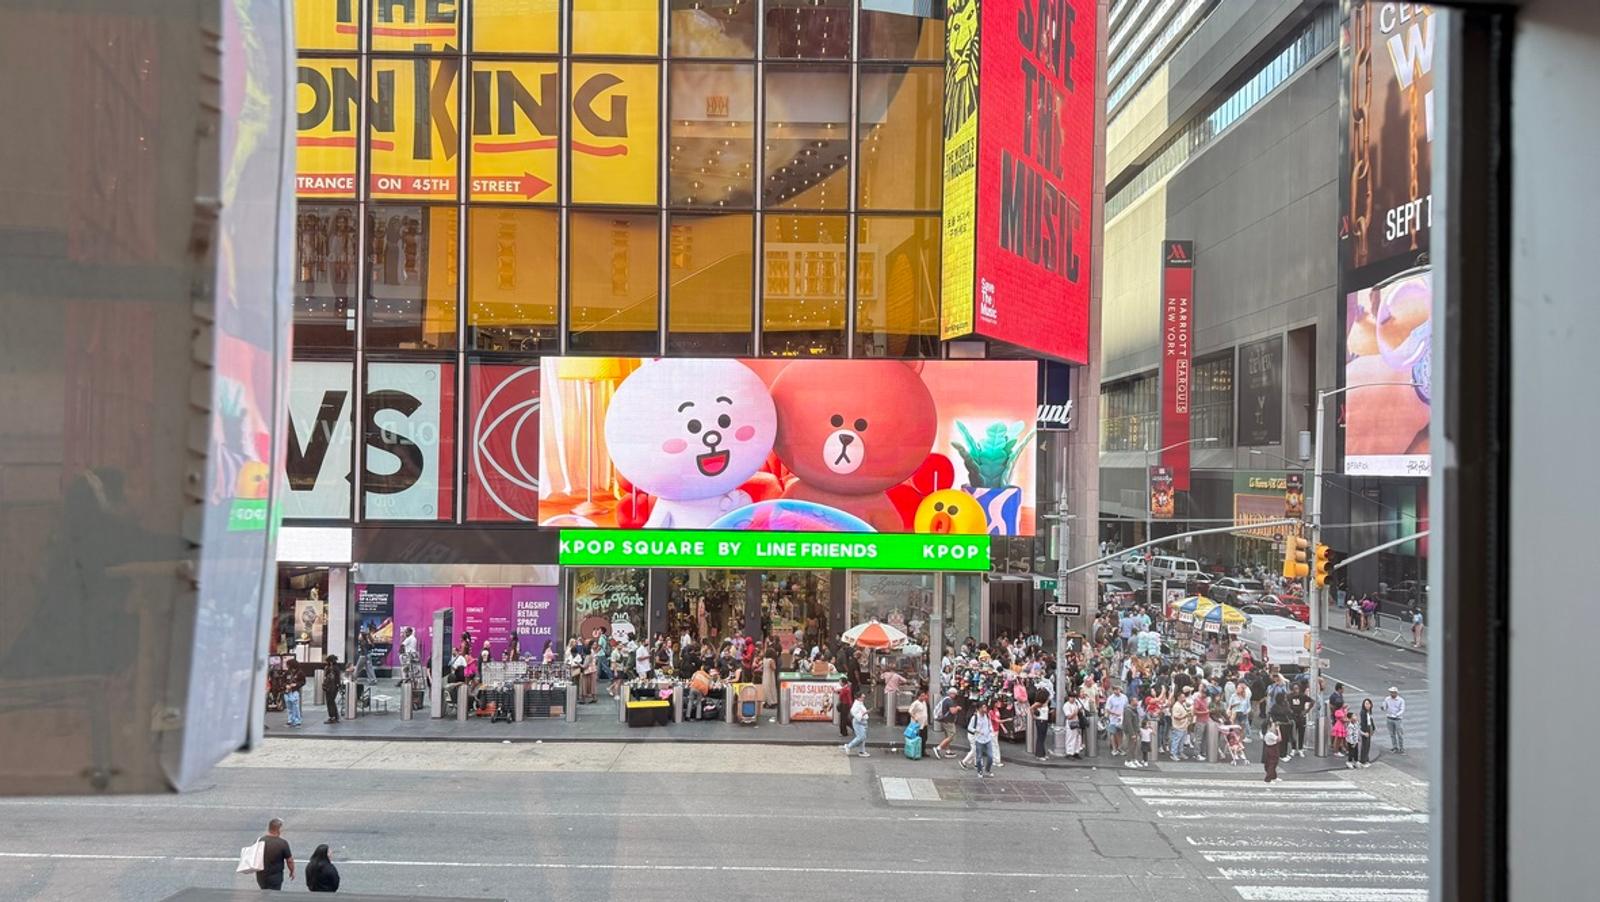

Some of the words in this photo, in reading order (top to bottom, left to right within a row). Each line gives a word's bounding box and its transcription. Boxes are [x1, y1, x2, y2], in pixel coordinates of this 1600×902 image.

[412, 44, 628, 160] KING
[1021, 56, 1066, 180] THE
[378, 178, 402, 190] ON
[412, 178, 449, 191] 45TH
[473, 180, 521, 193] STREET
[1000, 148, 1080, 284] MUSIC
[1386, 198, 1423, 241] SEPT
[1167, 298, 1176, 322] NEW
[1179, 298, 1188, 357] MARRIOTT
[1167, 328, 1176, 356] YORK
[560, 540, 615, 554] KPOP
[622, 540, 705, 556] SQUARE
[718, 542, 742, 556] BY
[756, 543, 797, 557] LINE
[801, 544, 878, 558] FRIENDS
[923, 545, 979, 559] KPOP
[517, 601, 550, 609] FLAGSHIP
[576, 596, 611, 611] New
[611, 593, 644, 608] York
[517, 610, 540, 618] RETAIL
[517, 618, 538, 626] SPACE
[516, 627, 530, 635] FOR
[532, 627, 551, 635] LEASE
[792, 684, 807, 694] FIND
